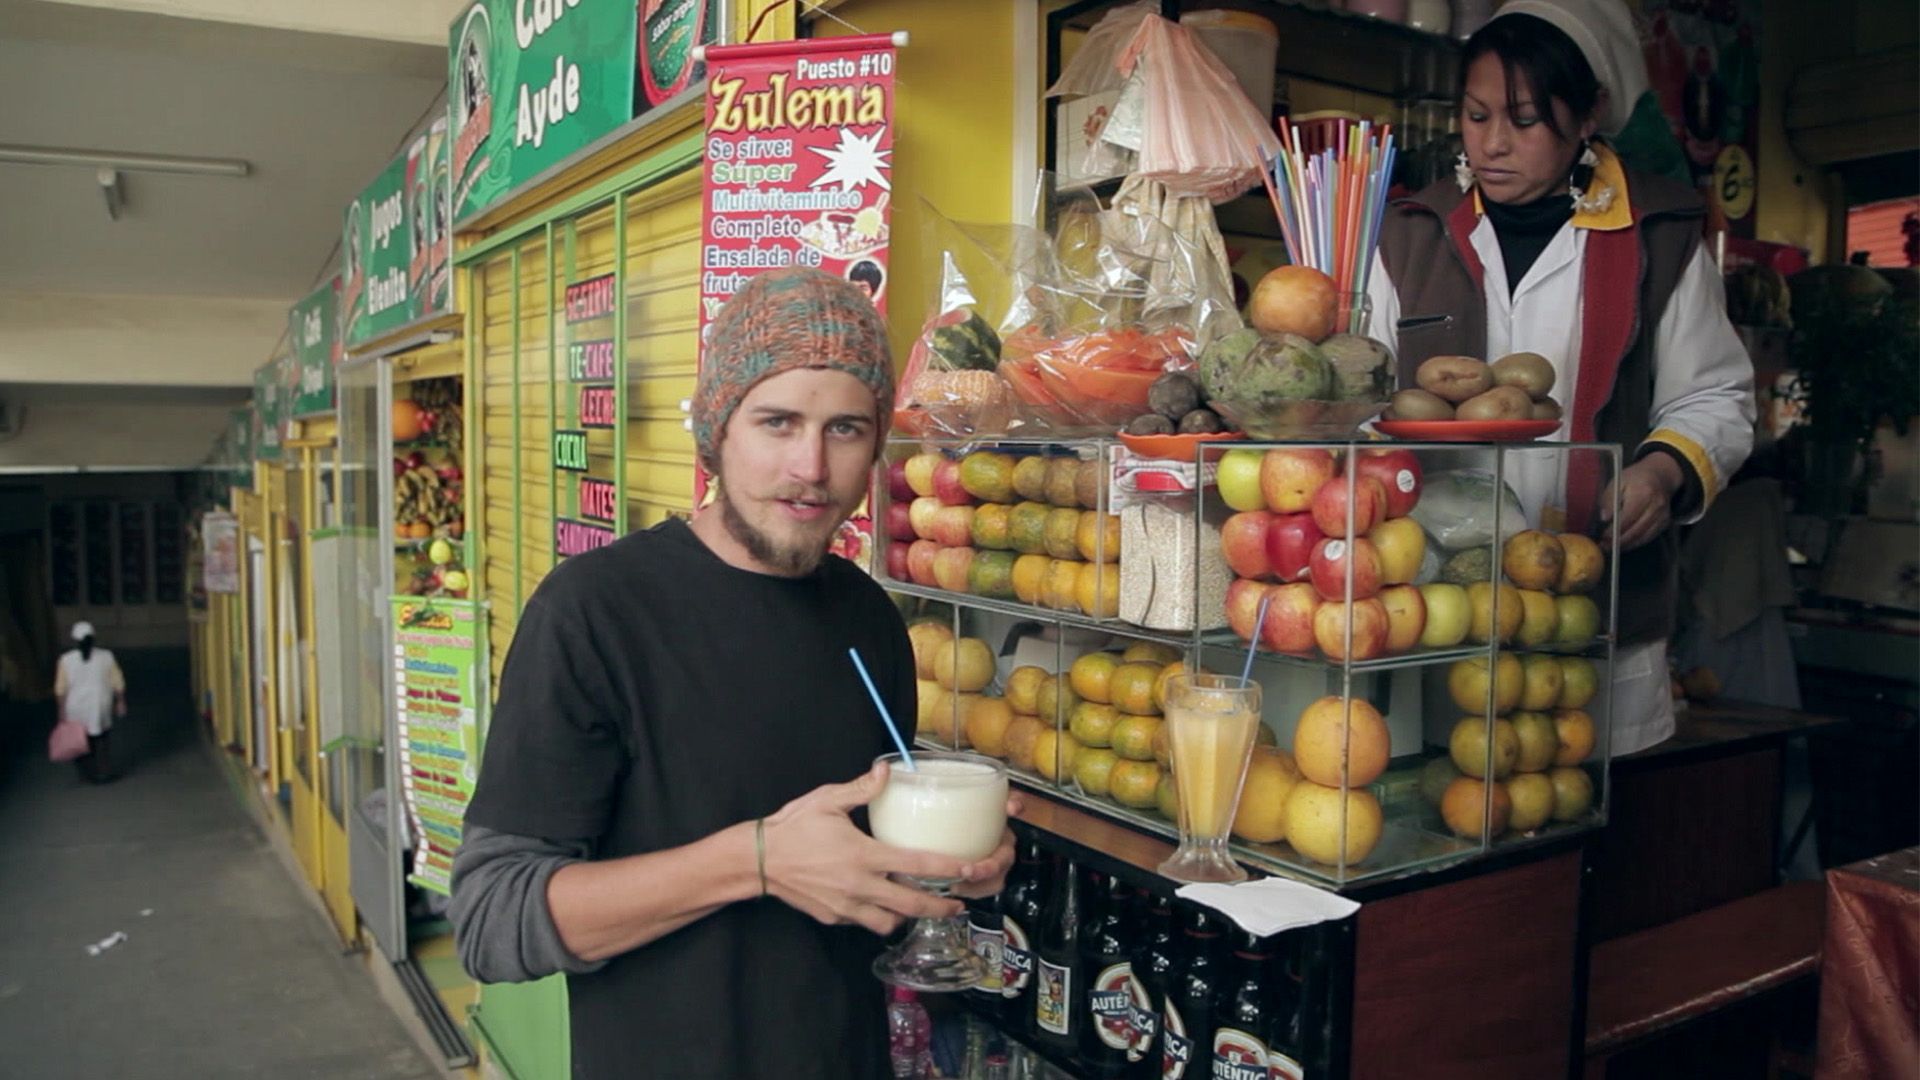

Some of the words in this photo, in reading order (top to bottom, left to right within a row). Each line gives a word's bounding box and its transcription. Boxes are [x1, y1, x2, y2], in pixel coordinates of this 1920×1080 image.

[516, 0, 580, 49] Ca
[797, 58, 856, 80] Puesto
[860, 53, 892, 77] #10
[516, 55, 580, 148] Ayde
[708, 68, 887, 135] Zulema
[709, 138, 732, 161] Se
[737, 137, 792, 159] sirve:
[712, 162, 797, 187] Súper
[712, 213, 803, 240] Completo
[705, 246, 791, 268] Ensalada
[797, 247, 822, 267] de
